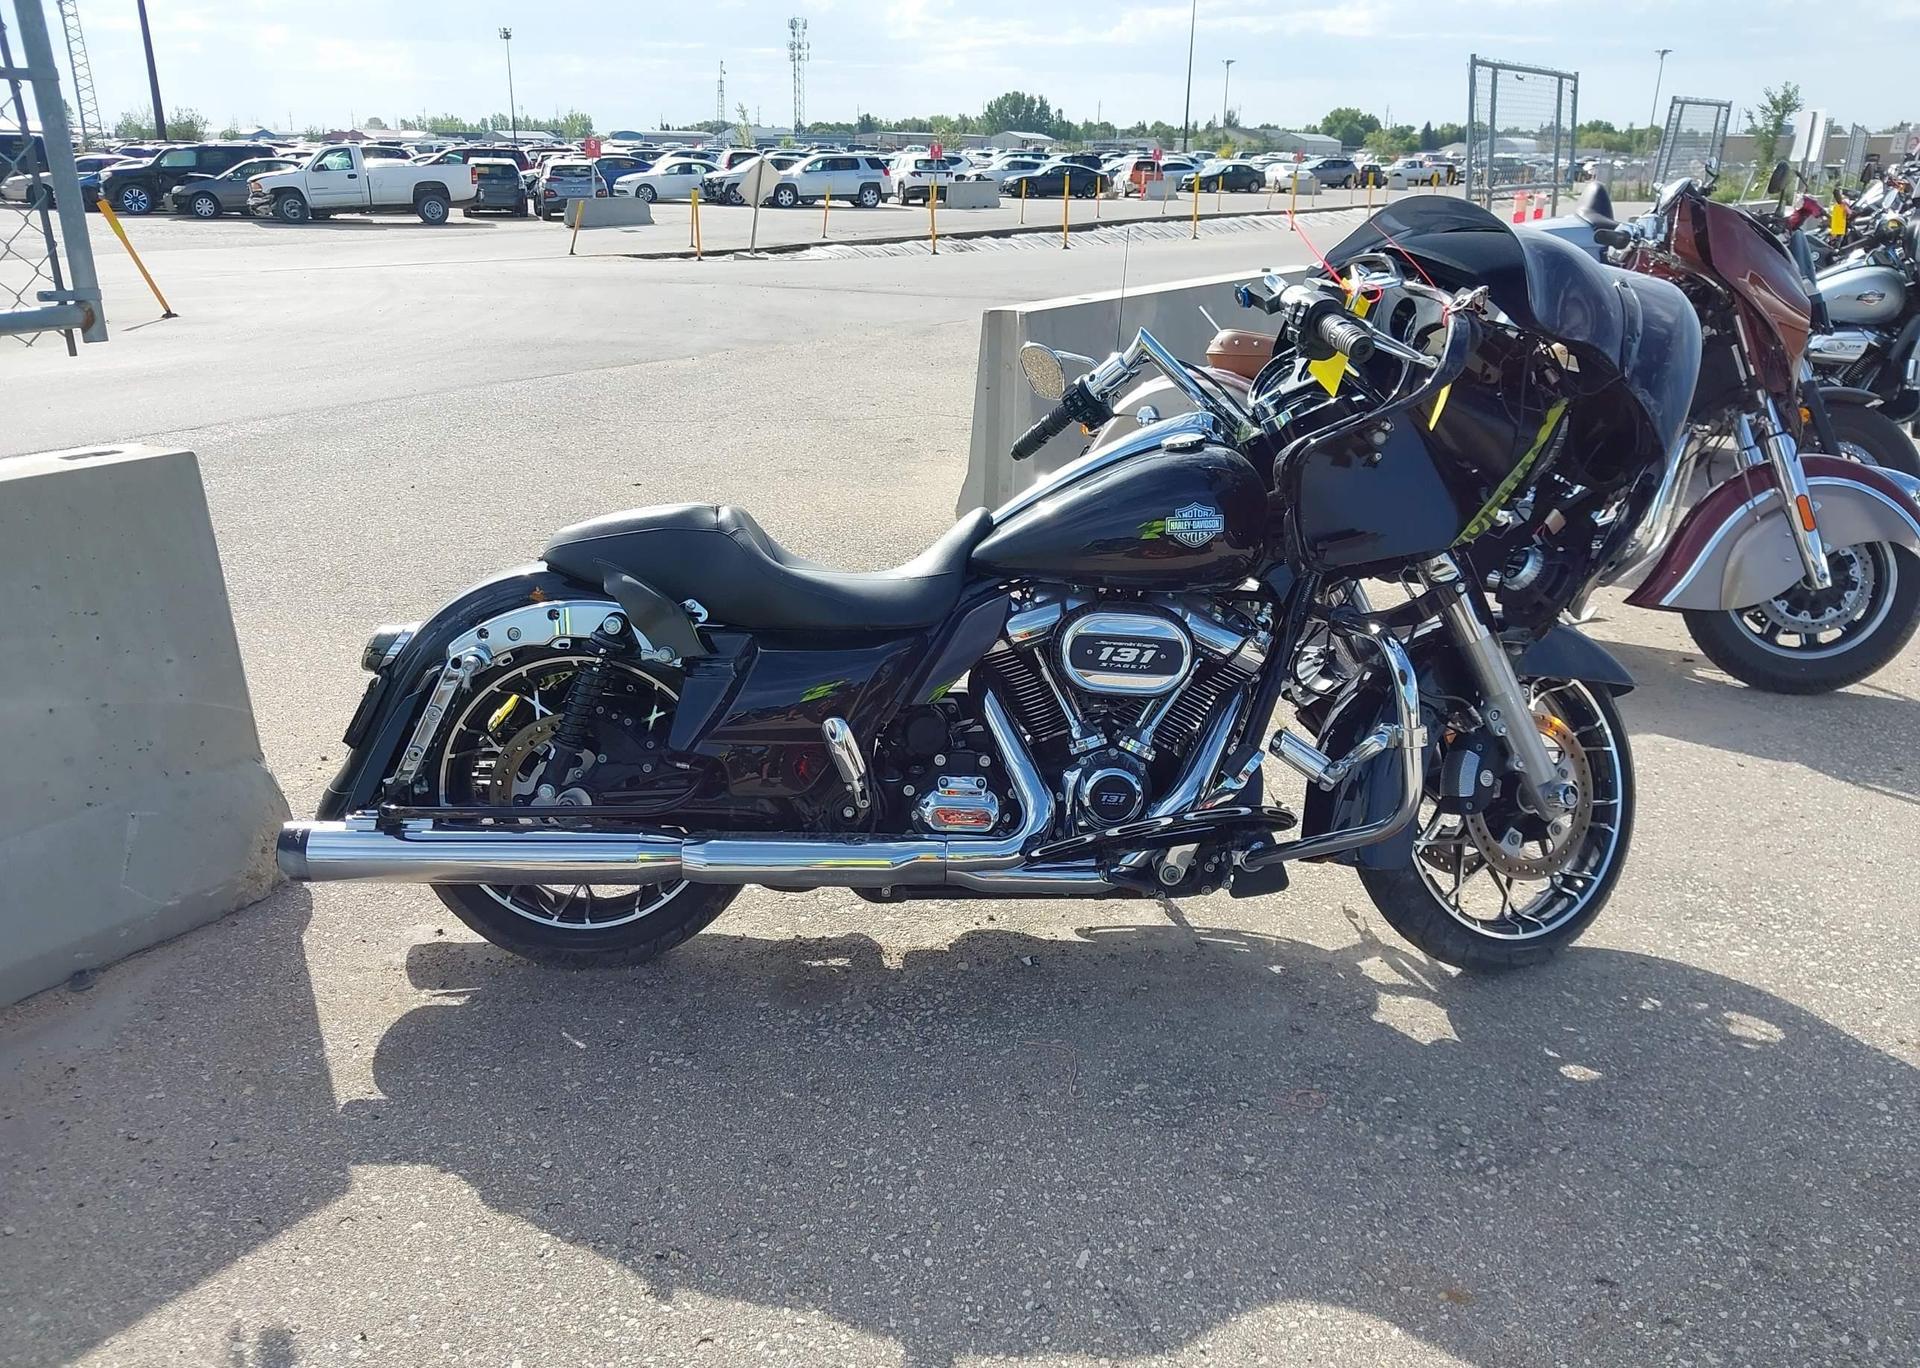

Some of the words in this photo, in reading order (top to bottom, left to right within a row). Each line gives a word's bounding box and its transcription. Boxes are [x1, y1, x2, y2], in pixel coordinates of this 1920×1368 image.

[1181, 508, 1209, 518] MOTOR
[1170, 519, 1220, 530] HARLEY-DAVIDSON
[1181, 531, 1209, 543] CYCLES
[1098, 646, 1156, 664] 131
[1101, 795, 1126, 803] 131
